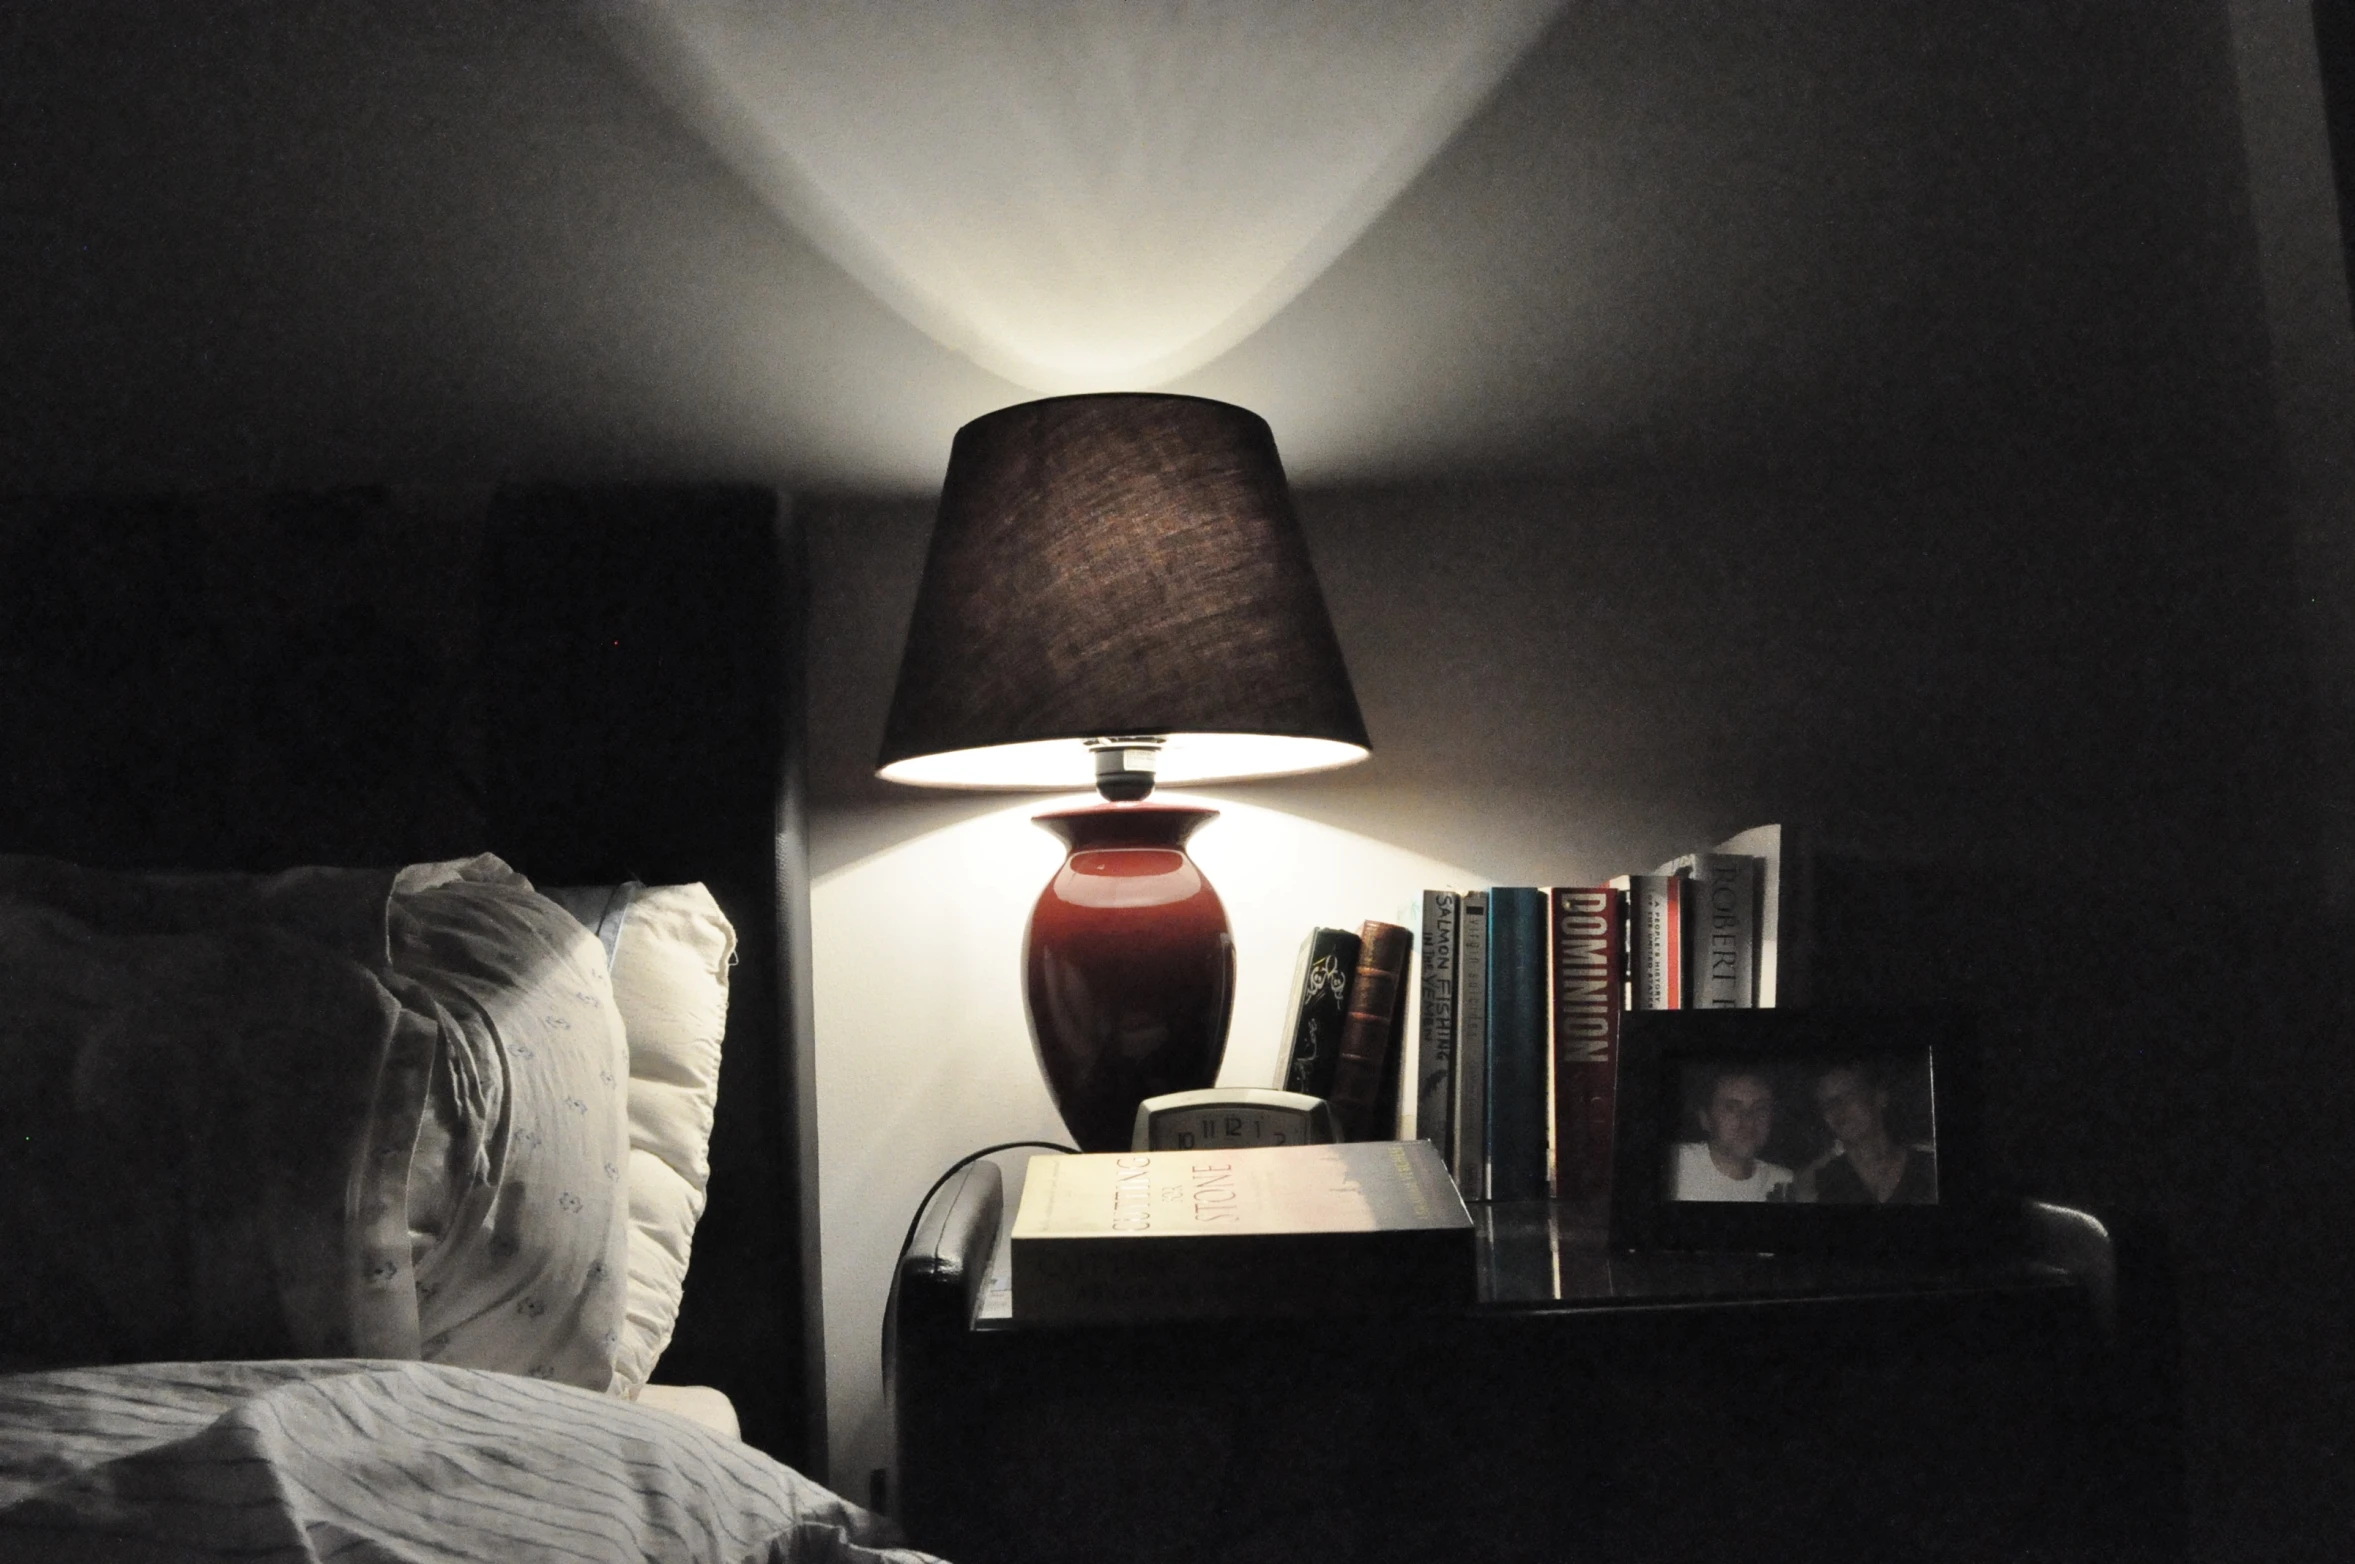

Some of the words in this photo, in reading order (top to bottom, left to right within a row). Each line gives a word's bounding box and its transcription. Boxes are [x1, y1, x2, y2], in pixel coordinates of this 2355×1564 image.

[1422, 932, 1432, 947] IN
[1435, 894, 1453, 970] SALMON
[1466, 919, 1480, 964] virgin
[1712, 863, 1740, 990] ROBERT
[1422, 974, 1439, 1043] YEMEN
[1467, 972, 1482, 1038] suicides
[1560, 892, 1609, 1063] DOMINION
[1435, 978, 1453, 1061] FISHING
[1201, 1119, 1216, 1139] 11
[1224, 1117, 1243, 1137] 12
[1253, 1120, 1262, 1139] 1
[1111, 1155, 1152, 1231] CUTTING
[1191, 1163, 1240, 1222] STONE
